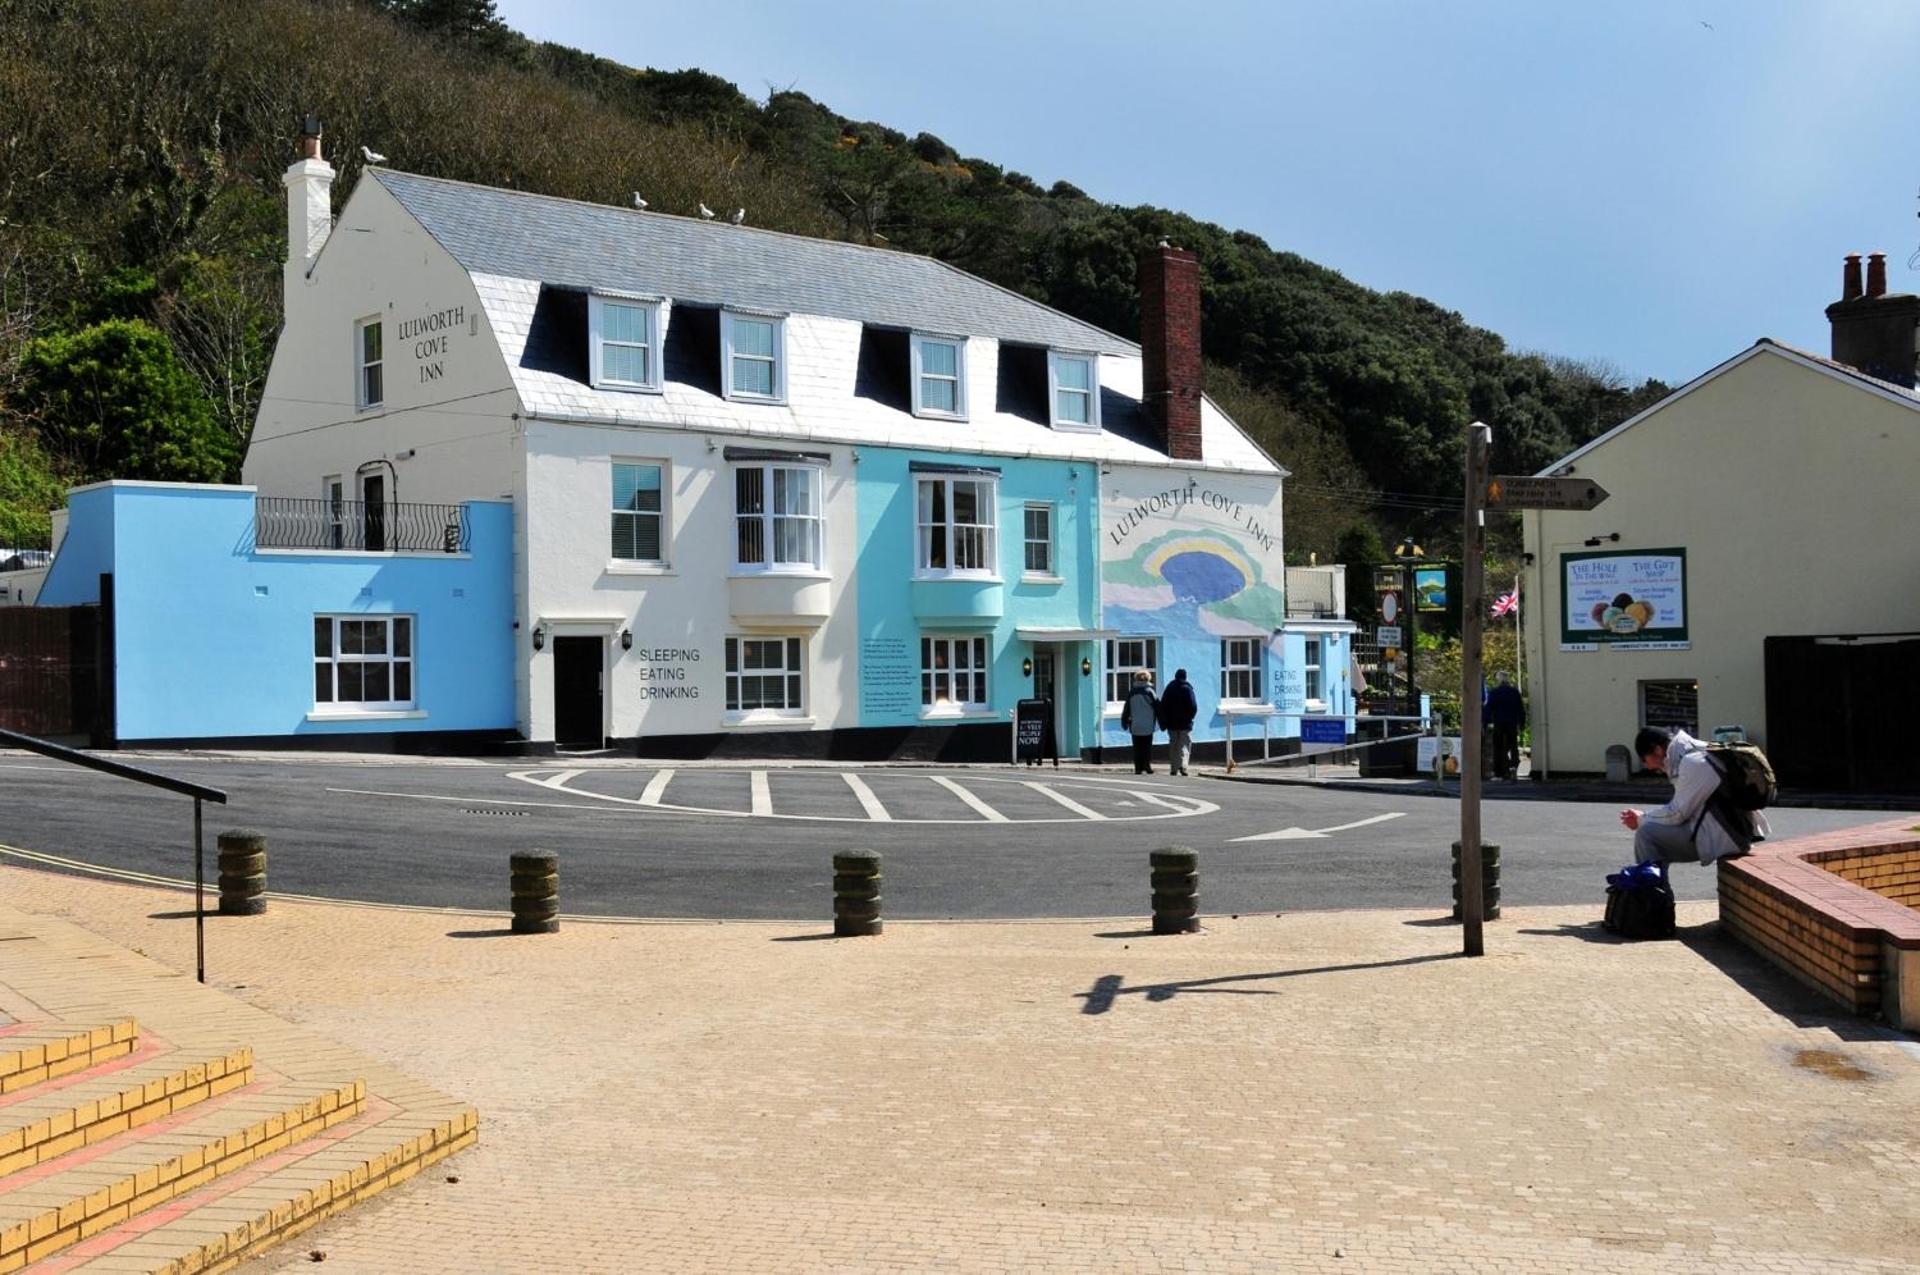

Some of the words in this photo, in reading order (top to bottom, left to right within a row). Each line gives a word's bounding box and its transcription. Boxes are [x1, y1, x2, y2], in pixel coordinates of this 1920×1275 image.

[399, 306, 464, 340] LULWORTH
[415, 336, 447, 359] COVE
[420, 361, 444, 383] INN
[1110, 488, 1194, 546] LULWORTH
[1201, 490, 1243, 522] COVE
[1246, 516, 1274, 552] INN
[1632, 561, 1651, 572] THE
[639, 648, 701, 662] SLEEPING
[639, 667, 686, 681] EATING
[639, 686, 700, 700] DRINKING
